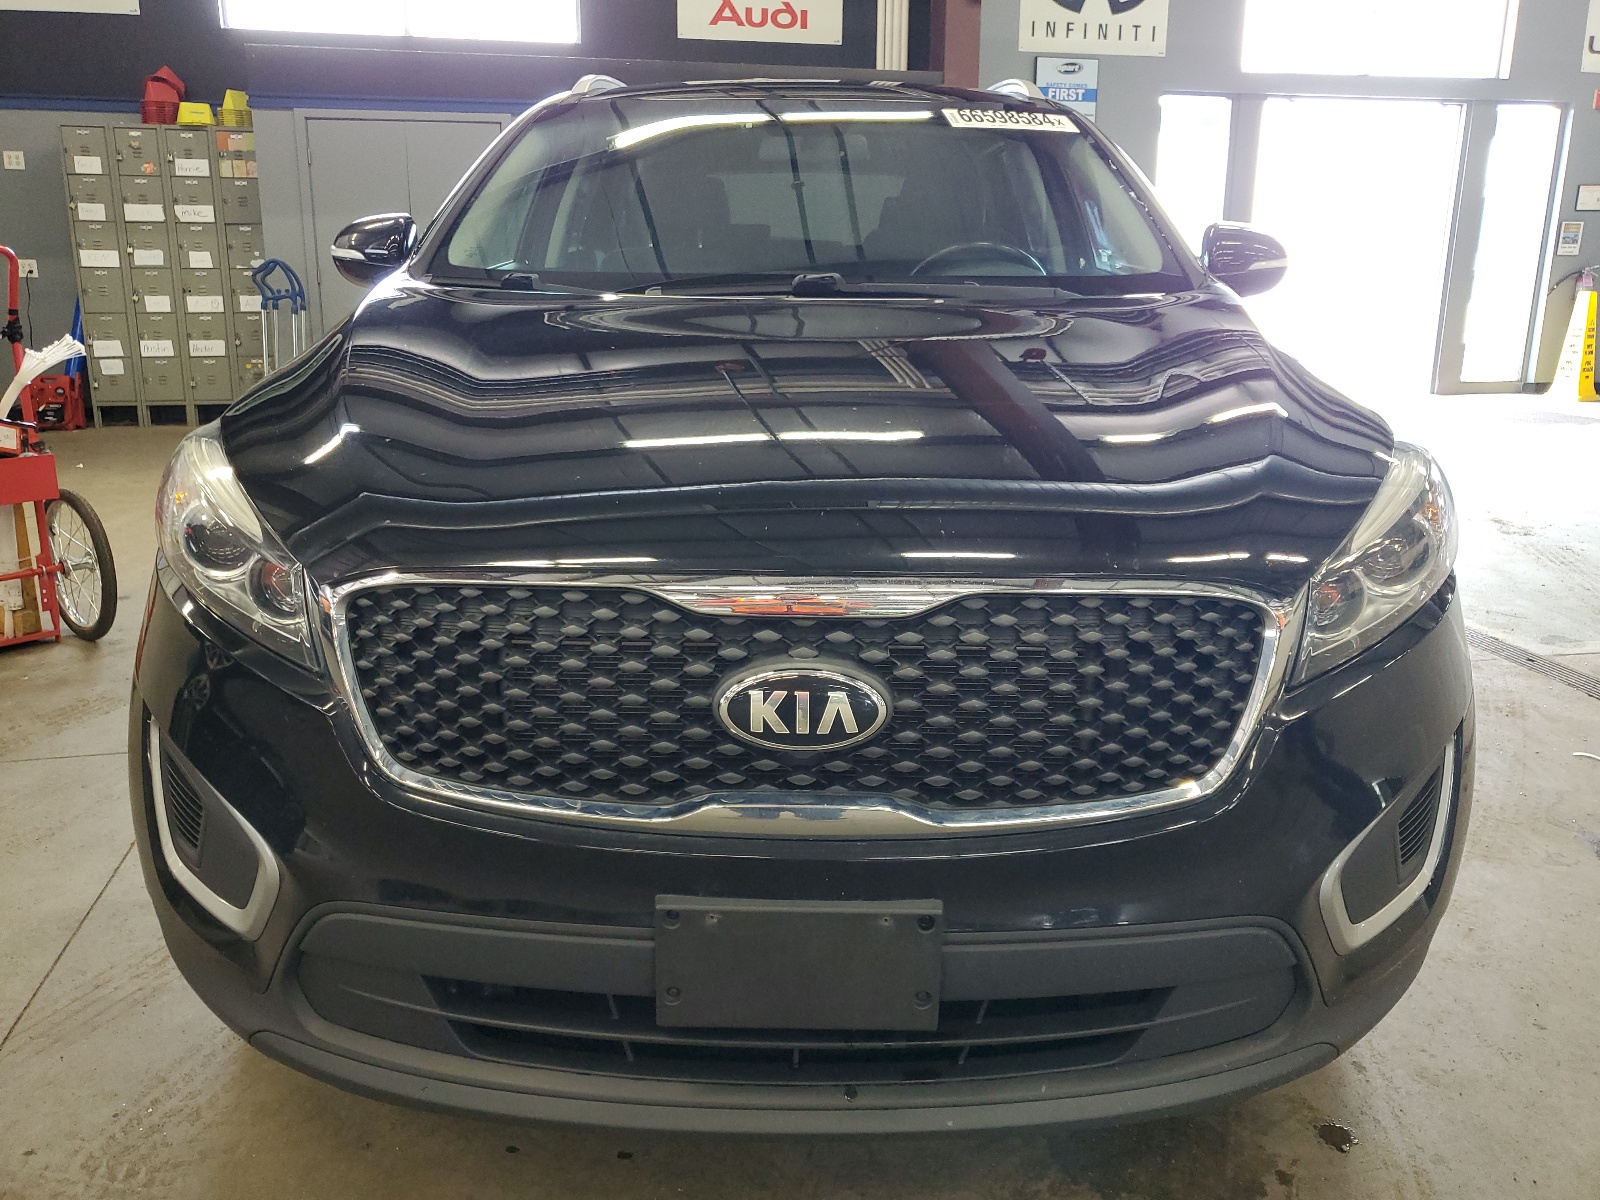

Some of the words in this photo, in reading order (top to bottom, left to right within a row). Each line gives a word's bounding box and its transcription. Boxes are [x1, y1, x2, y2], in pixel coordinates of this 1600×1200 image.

[708, 0, 808, 30] Audi
[1031, 20, 1156, 42] INFINITI
[1048, 88, 1086, 101] FIRST
[748, 690, 859, 735] KIA
